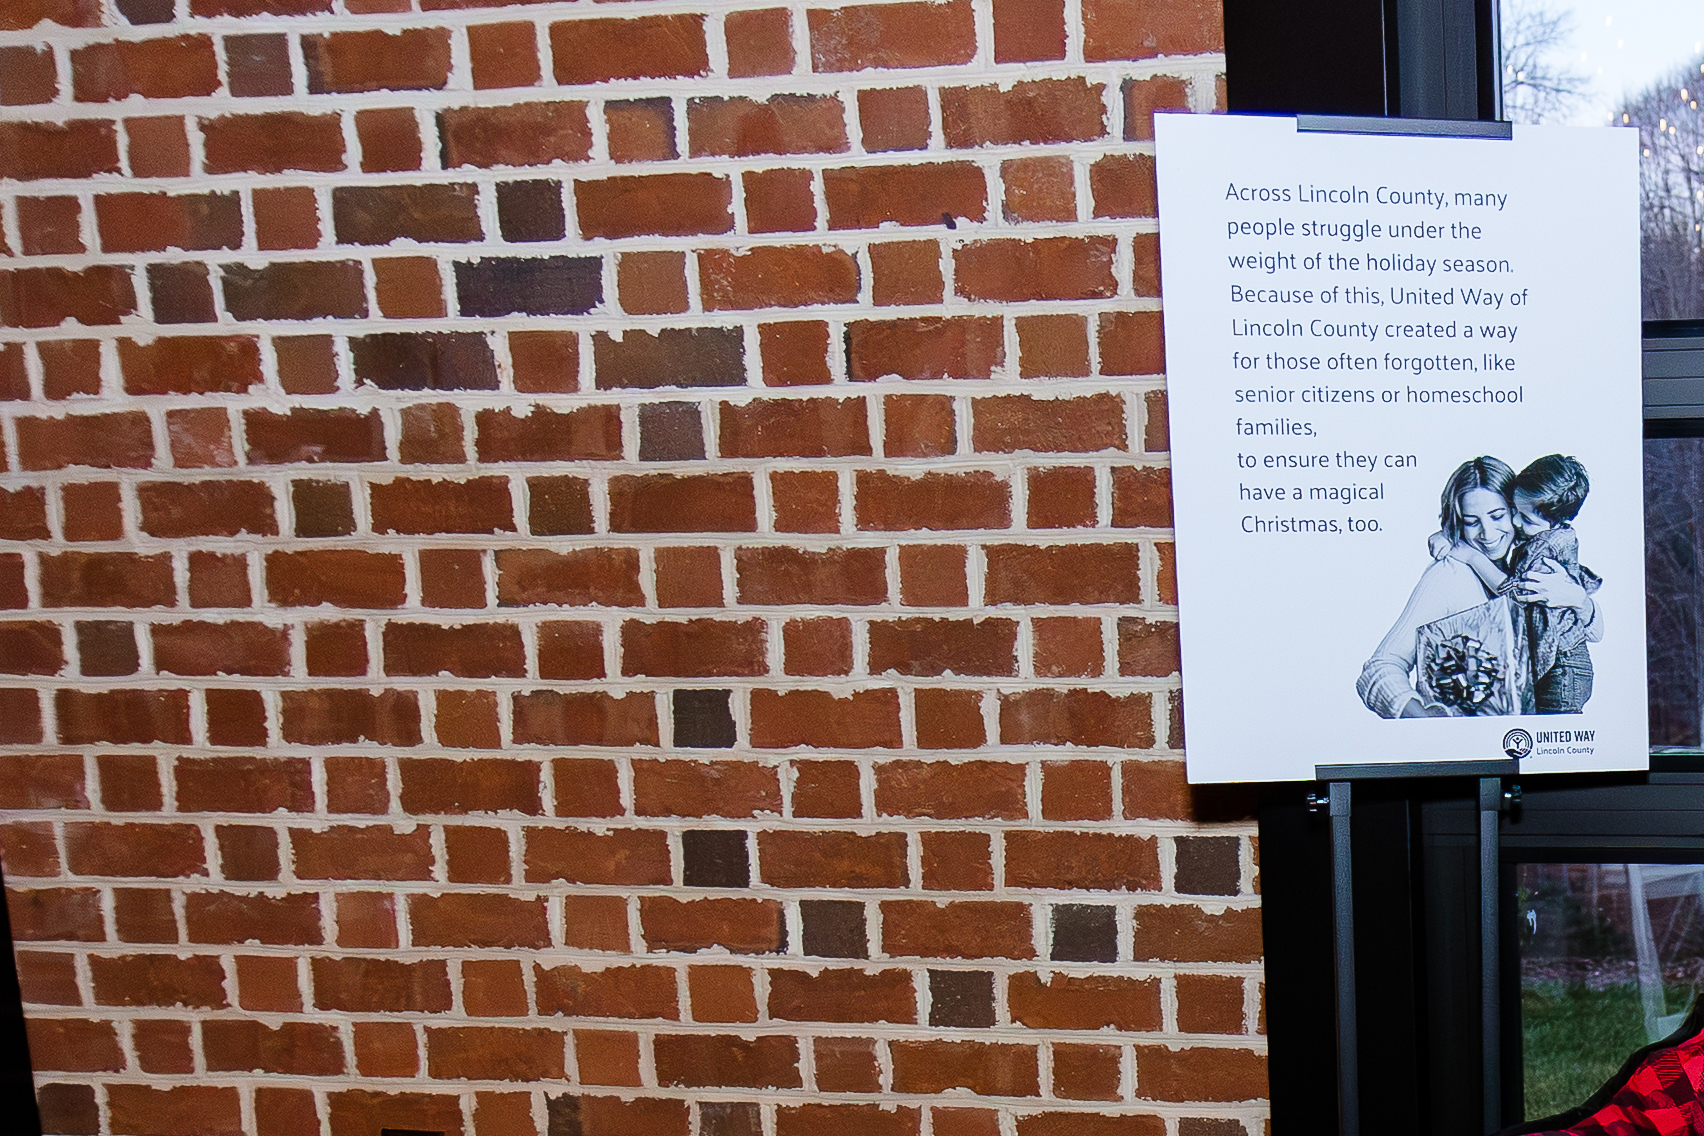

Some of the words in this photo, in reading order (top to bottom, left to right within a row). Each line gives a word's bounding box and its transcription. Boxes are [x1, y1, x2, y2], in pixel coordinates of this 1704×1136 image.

[1224, 182, 1292, 202] Across
[1298, 183, 1369, 204] Lincoln
[1376, 186, 1449, 211] County,
[1454, 192, 1508, 212] many
[1227, 217, 1295, 241] people
[1301, 218, 1382, 243] struggle
[1388, 220, 1446, 239] under
[1450, 221, 1482, 240] the
[1227, 250, 1298, 275] weight
[1303, 251, 1322, 271] of
[1327, 252, 1360, 271] the
[1366, 252, 1437, 277] holiday
[1442, 258, 1514, 274] season.
[1230, 284, 1314, 304] Because
[1320, 285, 1339, 304] of
[1344, 285, 1385, 307] this,
[1390, 286, 1454, 306] United
[1459, 287, 1504, 311] Way
[1510, 288, 1529, 306] of
[1232, 318, 1303, 337] Lincoln
[1310, 319, 1379, 342] County
[1384, 320, 1457, 339] created
[1463, 325, 1474, 339] a
[1479, 325, 1518, 344] way
[1232, 351, 1261, 370] for
[1265, 351, 1321, 371] those
[1327, 352, 1378, 371] often
[1383, 352, 1478, 376] forgotten,
[1483, 353, 1516, 372] like
[1234, 385, 1296, 403] senior
[1301, 385, 1375, 403] citizens
[1381, 390, 1401, 404] or
[1406, 385, 1523, 404] homeschool
[1235, 417, 1317, 438] families,
[1236, 452, 1257, 469] to
[1263, 454, 1330, 469] ensure
[1335, 450, 1378, 473] they
[1383, 454, 1417, 468] can
[1239, 482, 1286, 501] have
[1292, 487, 1303, 501] a
[1309, 482, 1384, 505] magical
[1241, 515, 1343, 535] Christmas,
[1347, 516, 1383, 533] too.
[1536, 730, 1572, 743] UNITED
[1574, 730, 1596, 742] WAY
[1536, 746, 1565, 755] Lincoln
[1566, 746, 1595, 755] County
